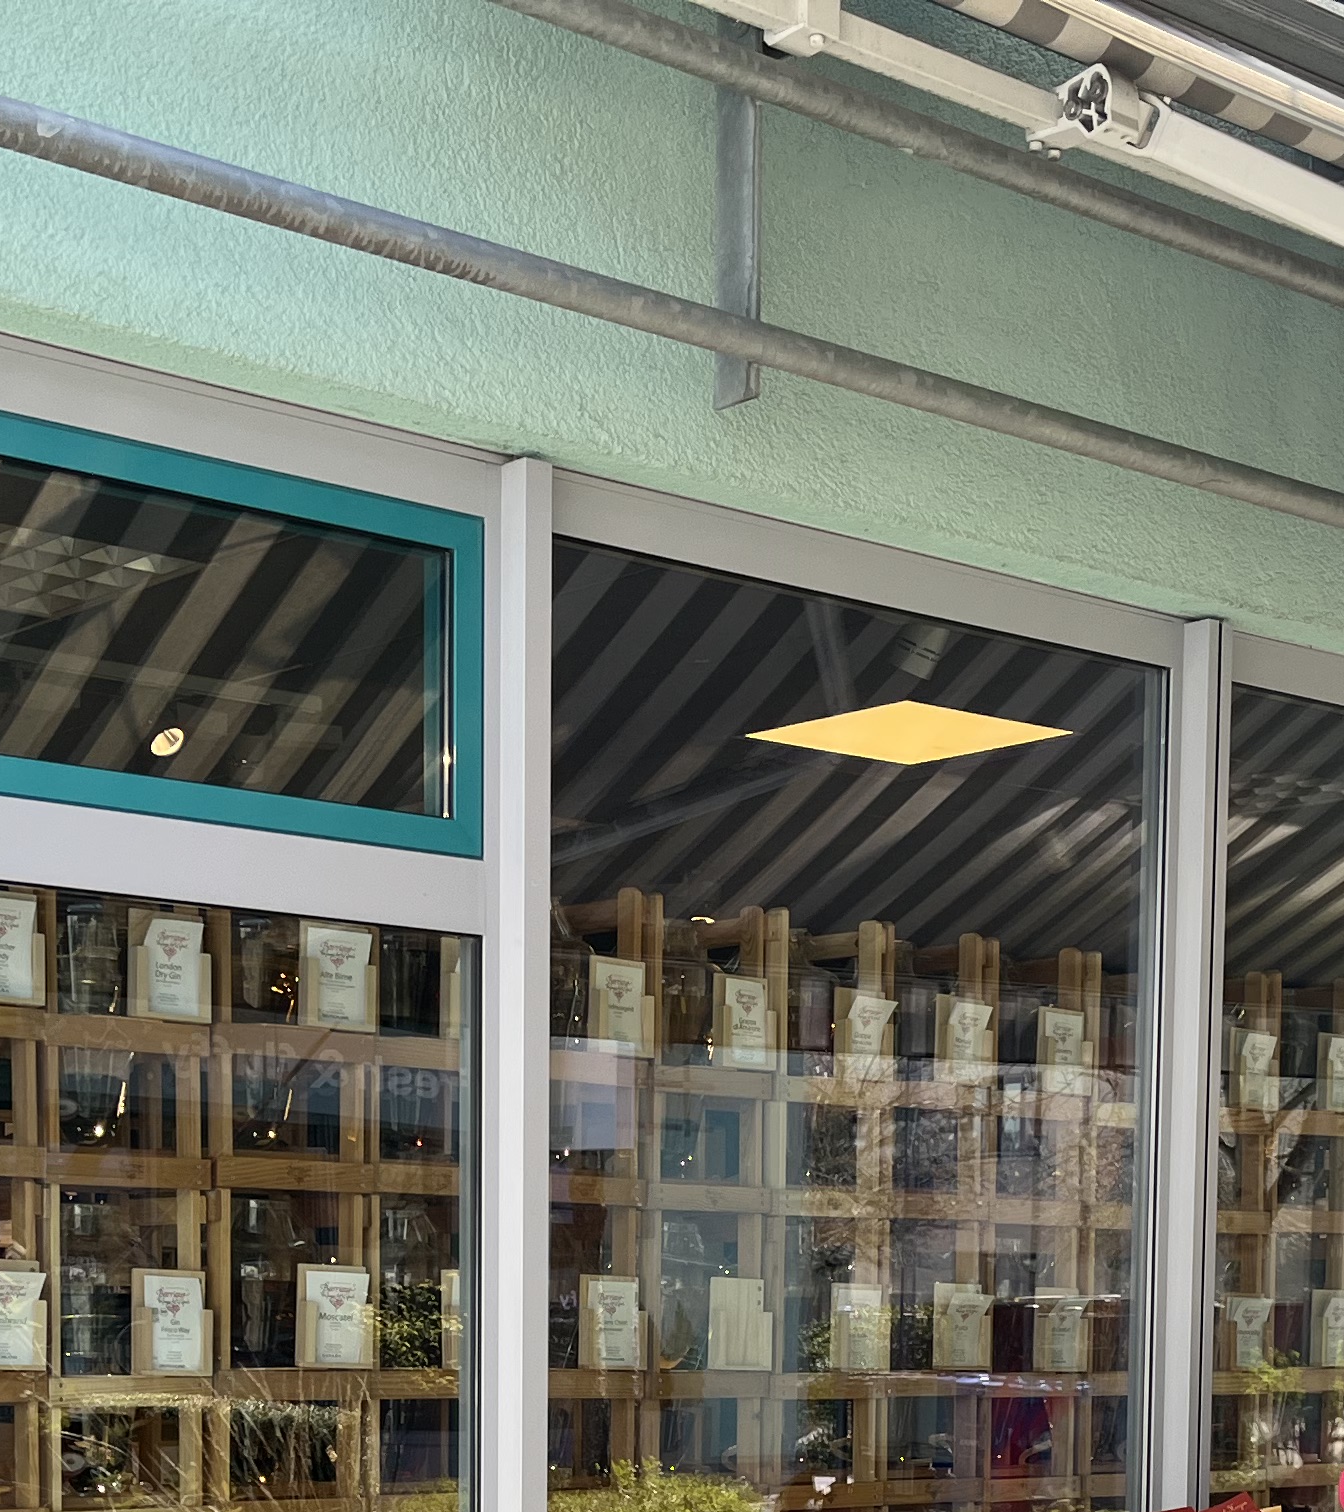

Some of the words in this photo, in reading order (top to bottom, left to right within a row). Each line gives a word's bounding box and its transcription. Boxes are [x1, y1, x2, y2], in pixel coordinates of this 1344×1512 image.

[155, 961, 182, 972] London
[155, 970, 168, 981] Dry
[169, 971, 182, 980] Gin
[169, 1318, 181, 1326] Gin
[319, 1312, 354, 1323] Moscatel
